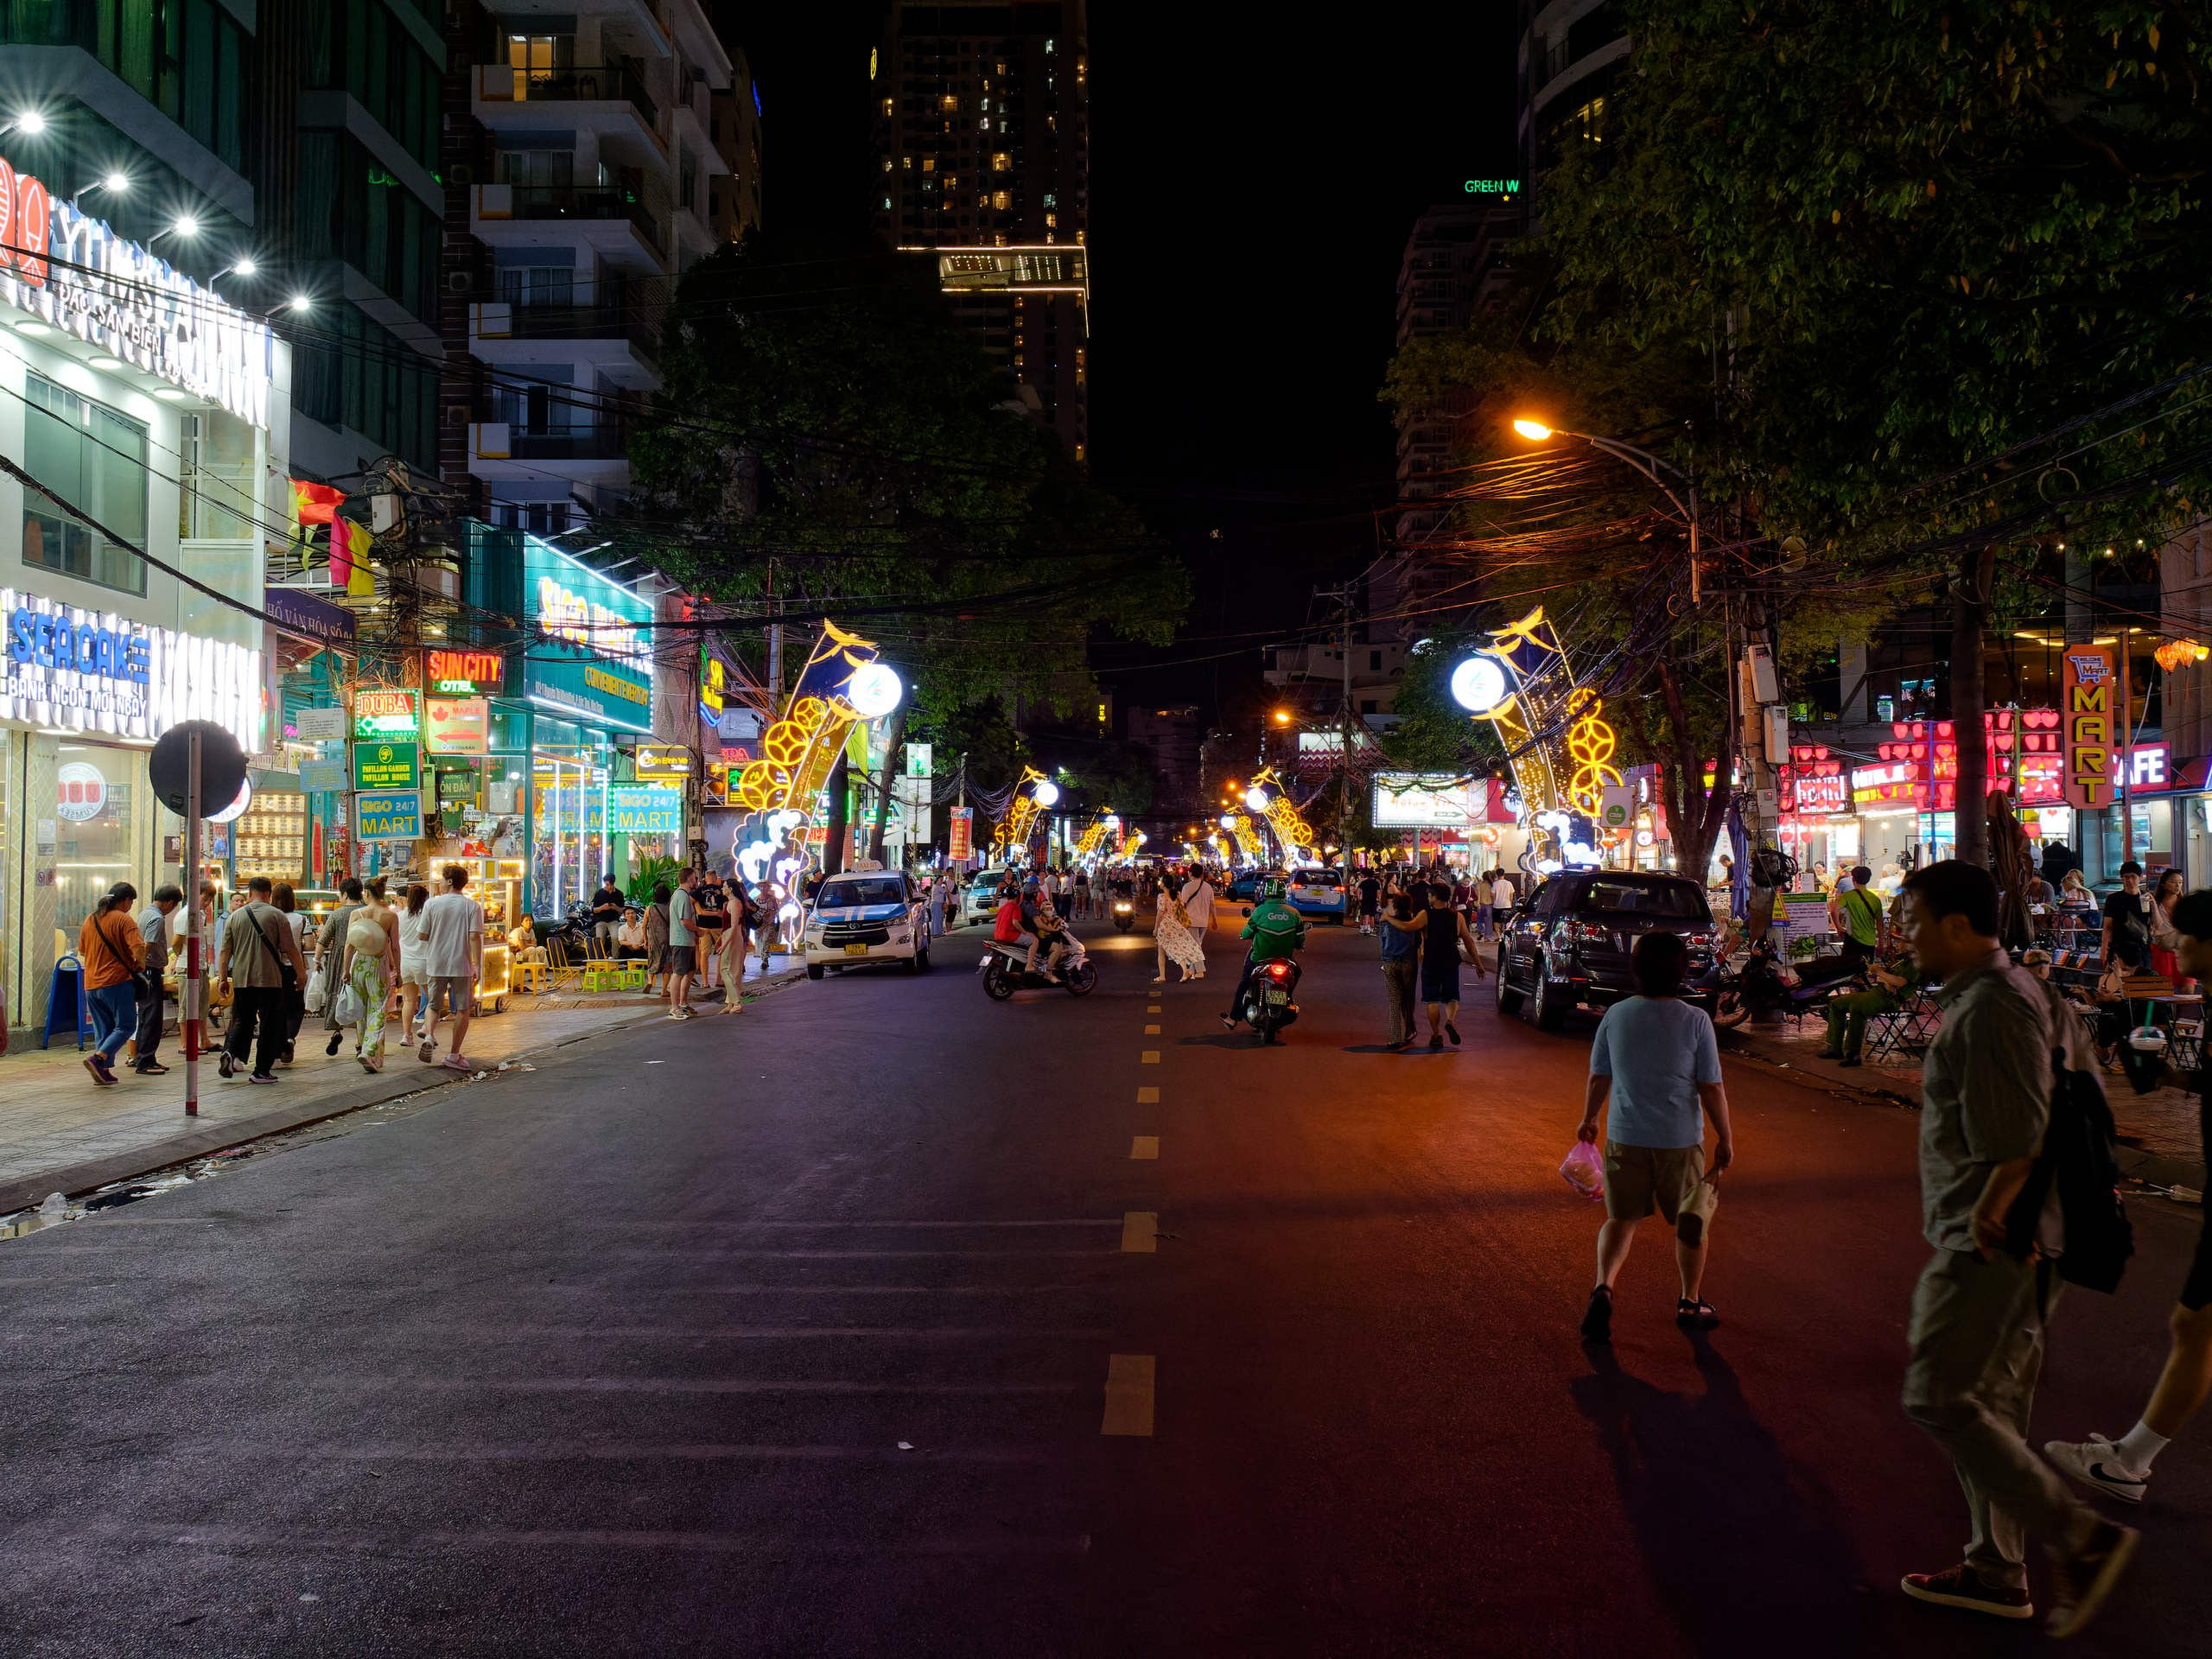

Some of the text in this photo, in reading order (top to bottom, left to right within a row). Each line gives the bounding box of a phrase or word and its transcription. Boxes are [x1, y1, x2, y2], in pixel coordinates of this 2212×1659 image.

[1465, 180, 1503, 193] GREEN
[429, 651, 500, 682] SUN CITY
[433, 679, 477, 693] HOTEL
[359, 695, 410, 715] DUBA
[2074, 686, 2107, 804] MART
[361, 800, 393, 813] SIGO
[618, 794, 651, 806] SIGO
[362, 817, 416, 835] MART
[618, 811, 673, 828] MART
[1267, 912, 1289, 921] Grab
